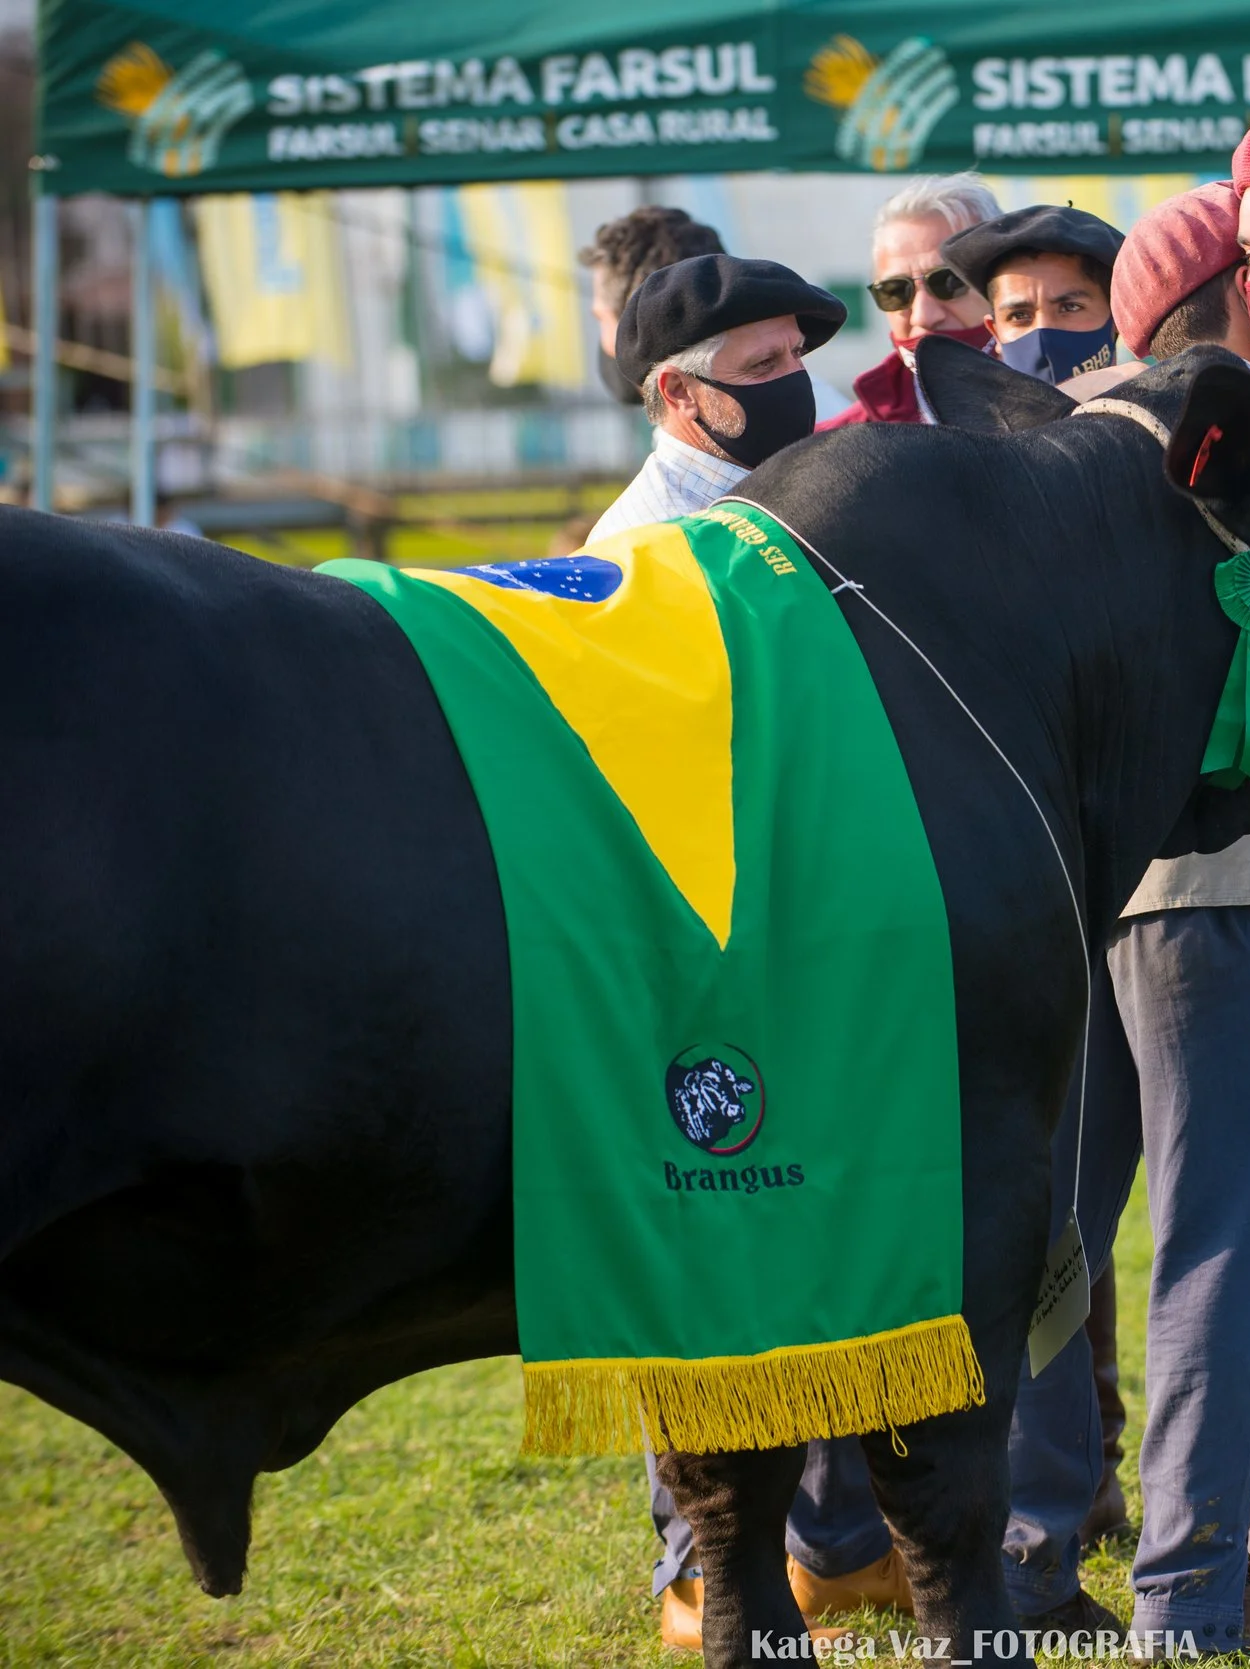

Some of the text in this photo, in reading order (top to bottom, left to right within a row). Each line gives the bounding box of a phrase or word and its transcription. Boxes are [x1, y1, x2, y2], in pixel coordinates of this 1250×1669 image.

[266, 43, 776, 115] SISTEMA FARSUL
[972, 53, 1234, 110] SISTEMA
[267, 107, 778, 161] FARSUL SENAR CASA RURAL
[972, 119, 1108, 159] FARSUL
[1122, 115, 1245, 154] SENAR
[758, 546, 797, 576] RES
[663, 1161, 805, 1194] Brangus
